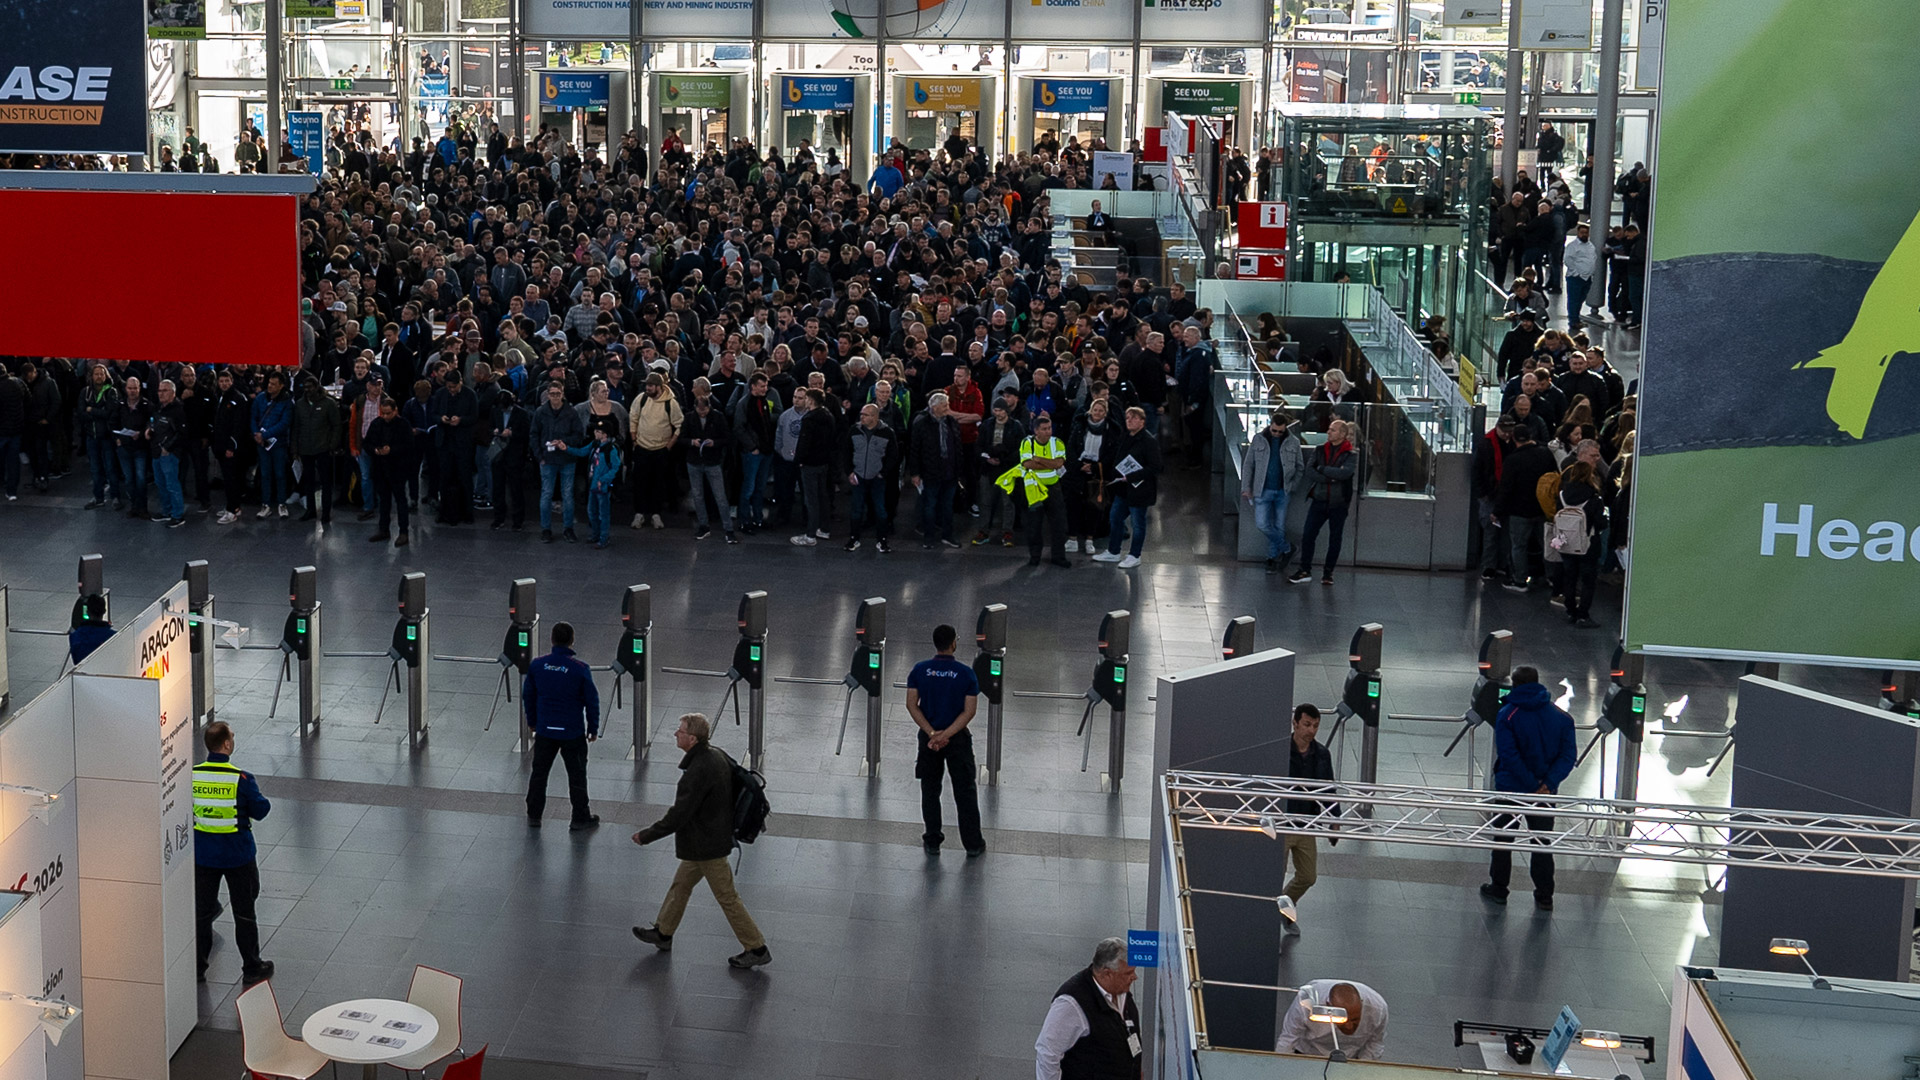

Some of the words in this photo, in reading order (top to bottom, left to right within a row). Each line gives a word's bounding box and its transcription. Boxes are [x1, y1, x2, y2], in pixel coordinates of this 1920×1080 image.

[552, 1, 613, 9] CONSTRUCTION
[615, 1, 664, 9] MACNERY
[666, 1, 683, 9] AND
[685, 1, 713, 9] MINING
[715, 1, 753, 9] INDUSTRY
[1297, 31, 1345, 42] DEVELON
[853, 55, 874, 64] Too
[559, 81, 574, 89] SEE
[575, 81, 592, 89] YOU
[680, 82, 695, 90] SEE
[696, 82, 714, 90] YOU
[804, 84, 818, 92] SEE
[820, 84, 838, 92] YOU
[929, 85, 944, 93] SEE
[946, 85, 963, 93] YOU
[1058, 87, 1074, 95] SEE
[1075, 87, 1093, 95] YOU
[1174, 88, 1190, 96] SEE
[1191, 88, 1210, 97] YOU
[140, 609, 185, 669] ARAGON
[543, 662, 569, 674] Security
[926, 667, 958, 679] Security
[192, 786, 232, 795] SECURITY
[33, 853, 63, 896] 2026
[1129, 936, 1157, 947] bauma
